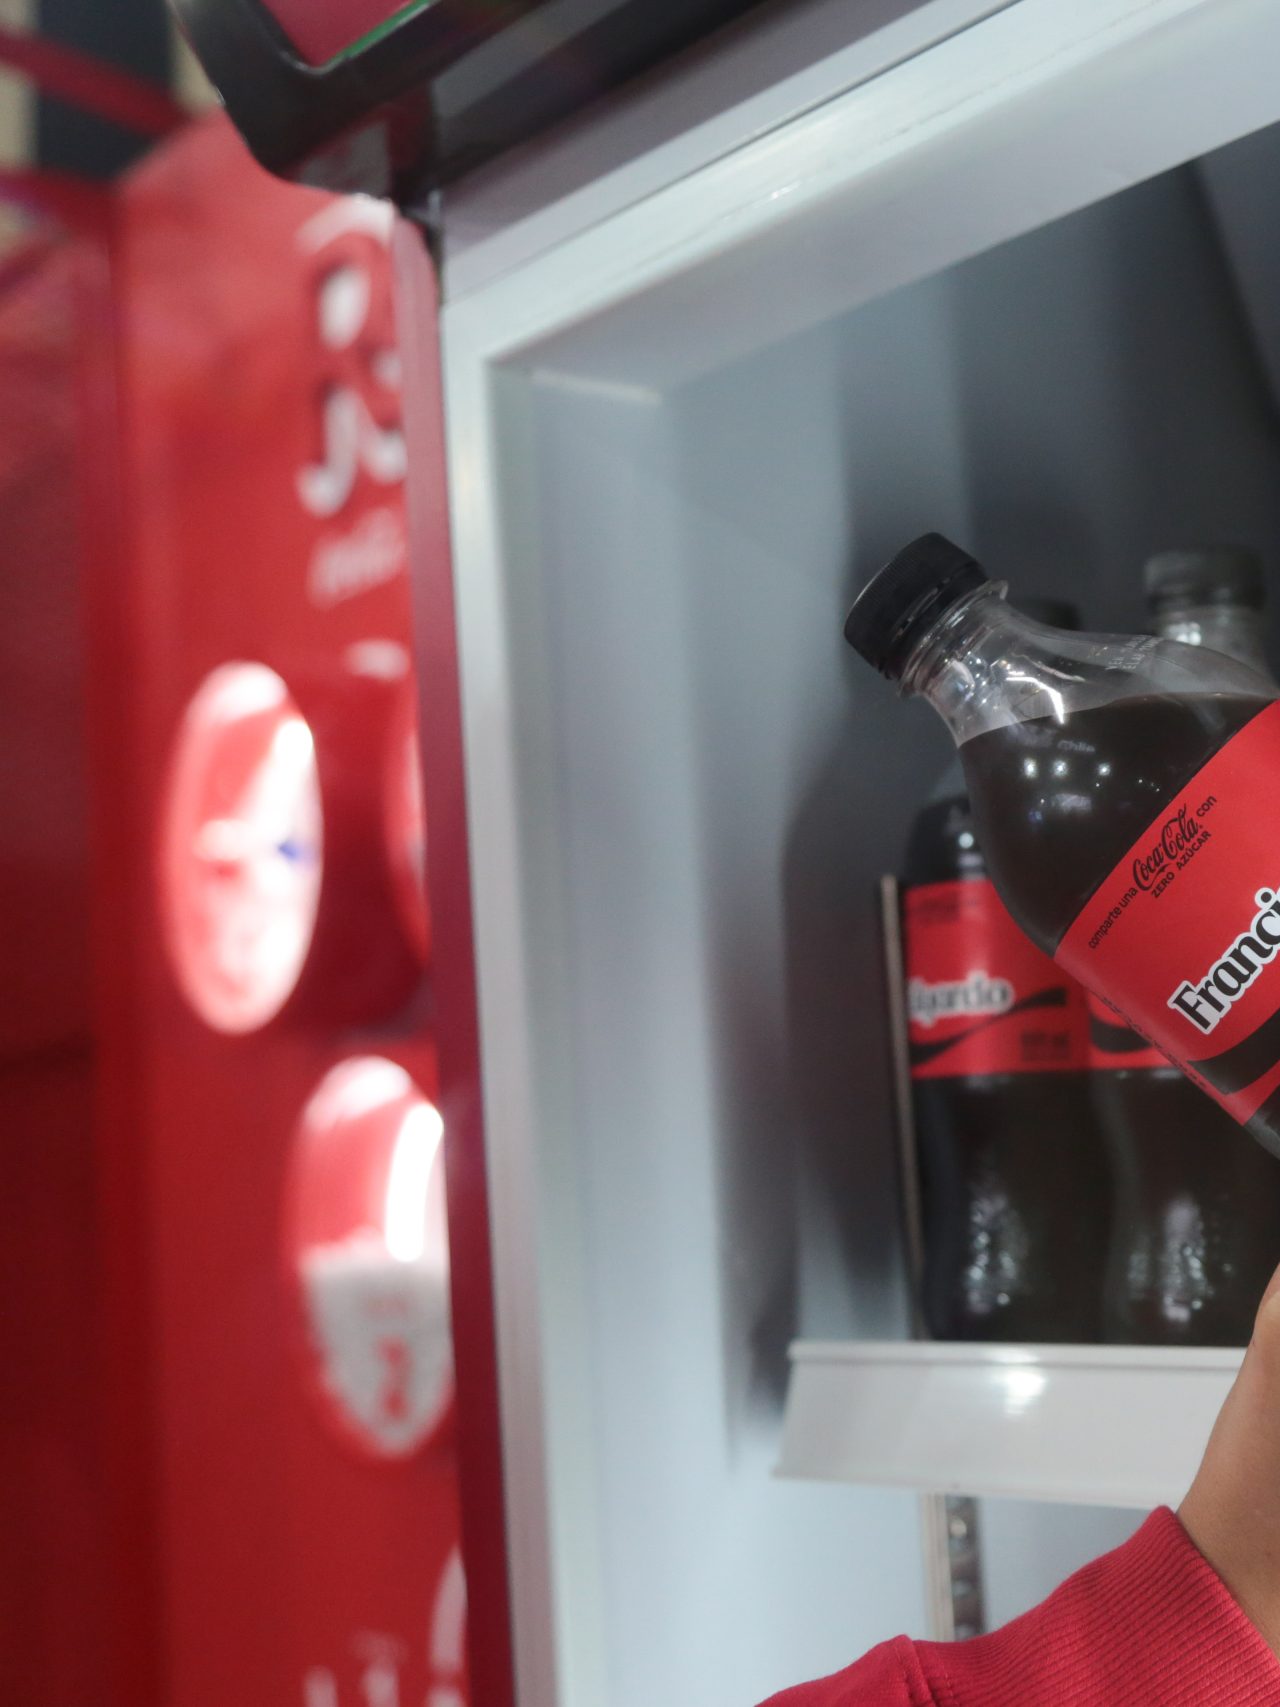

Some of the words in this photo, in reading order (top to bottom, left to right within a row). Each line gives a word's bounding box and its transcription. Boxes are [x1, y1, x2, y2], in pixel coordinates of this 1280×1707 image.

[1088, 905, 1122, 949] comparte
[1119, 886, 1139, 909] una
[1132, 802, 1199, 892] Coca-Cola
[1196, 795, 1218, 818] con
[1151, 871, 1175, 898] ZERO
[1175, 829, 1212, 870] AZÚCAR
